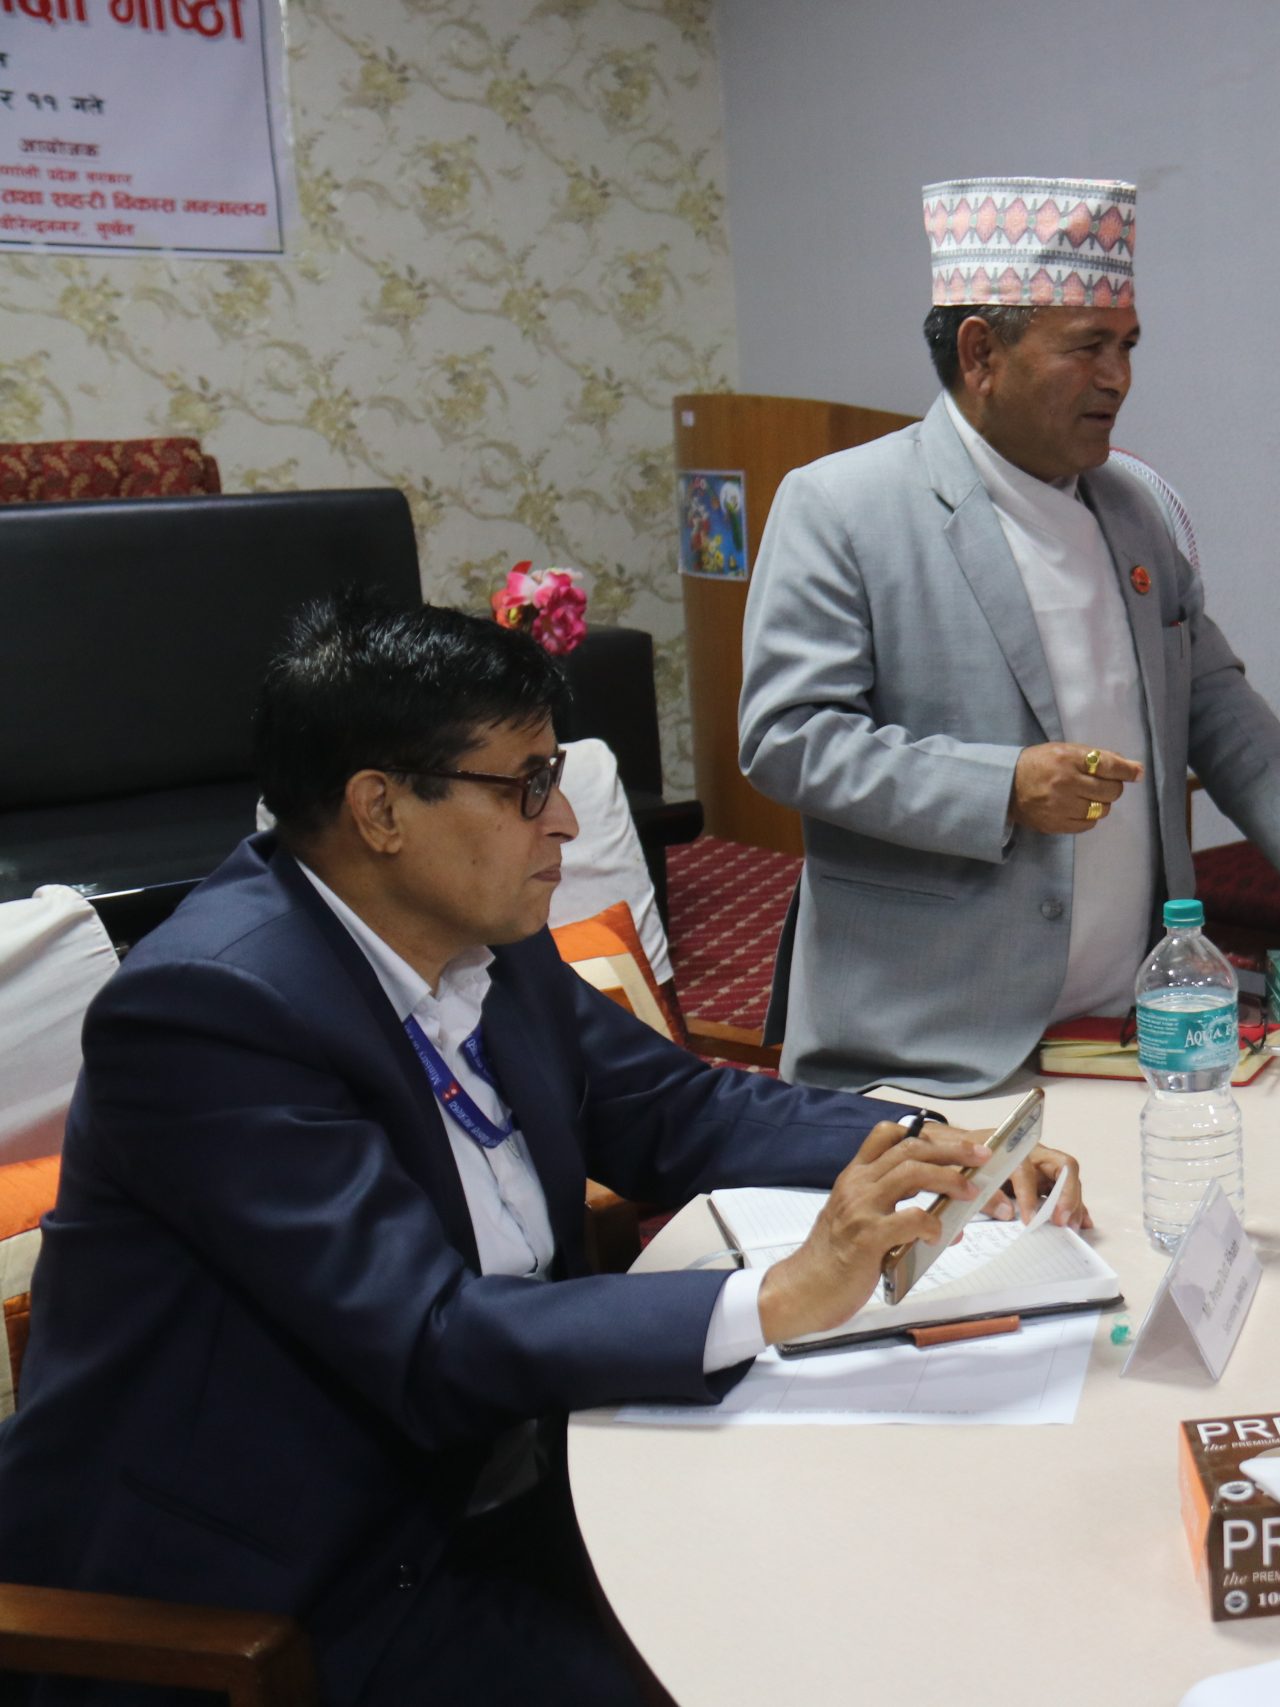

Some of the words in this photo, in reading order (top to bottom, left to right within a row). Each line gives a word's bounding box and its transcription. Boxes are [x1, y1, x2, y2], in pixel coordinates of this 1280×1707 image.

[26, 92, 58, 111] ११
[112, 191, 176, 212] विकास
[1204, 1443, 1228, 1452] the
[1231, 1437, 1280, 1449] PREMIUM
[1223, 1572, 1248, 1587] the
